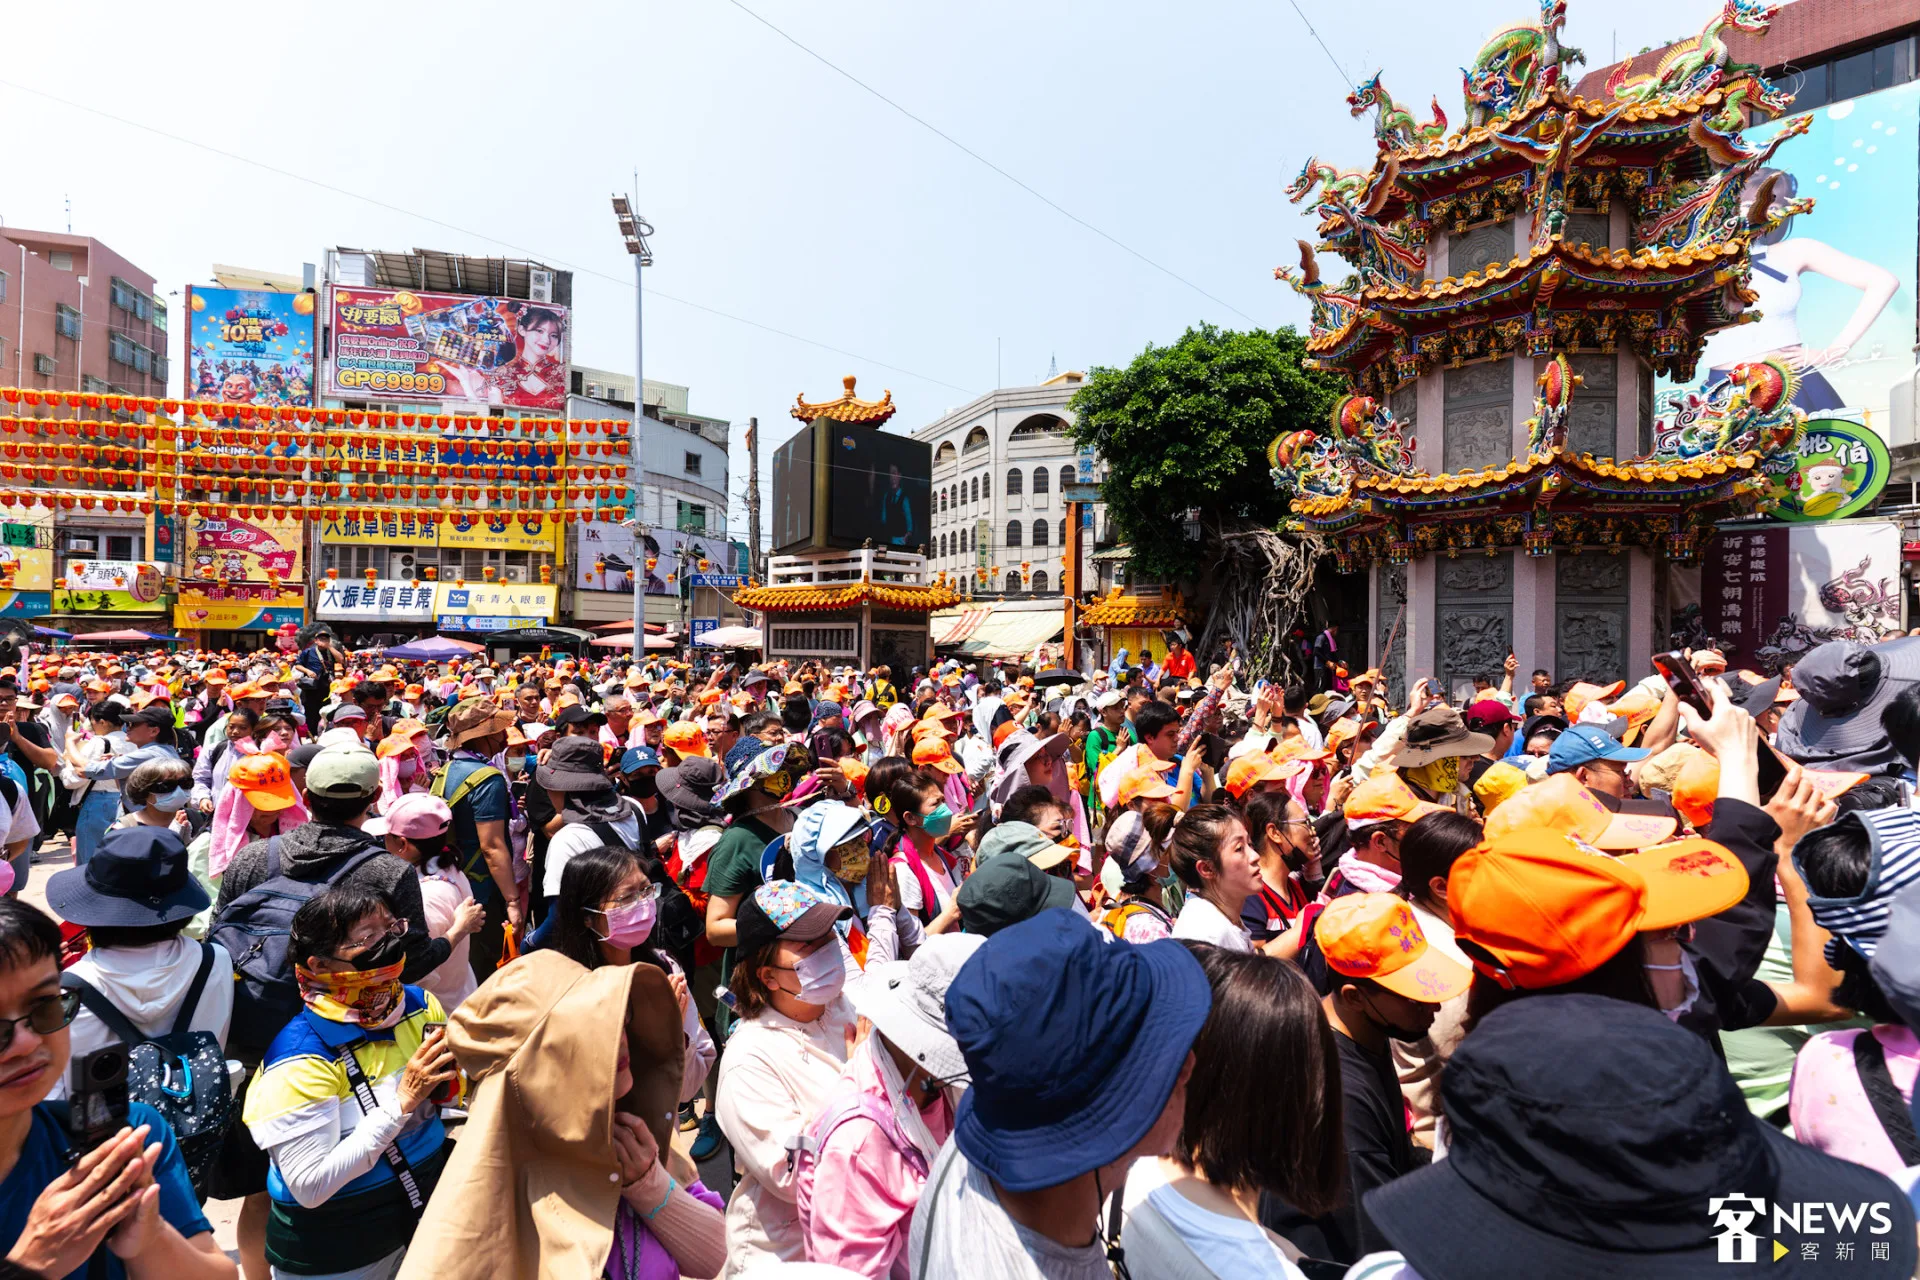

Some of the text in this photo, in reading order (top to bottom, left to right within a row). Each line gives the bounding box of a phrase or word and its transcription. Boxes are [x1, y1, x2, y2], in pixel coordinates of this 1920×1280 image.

[221, 325, 263, 342] 10萬
[338, 370, 444, 393] GPC9999
[1722, 536, 1743, 634] 祈安七朝清醮
[207, 587, 277, 601] 補財庫
[475, 594, 546, 605] 年青人眼鏡
[636, 750, 649, 761] LA
[399, 1170, 423, 1209] PUMA
